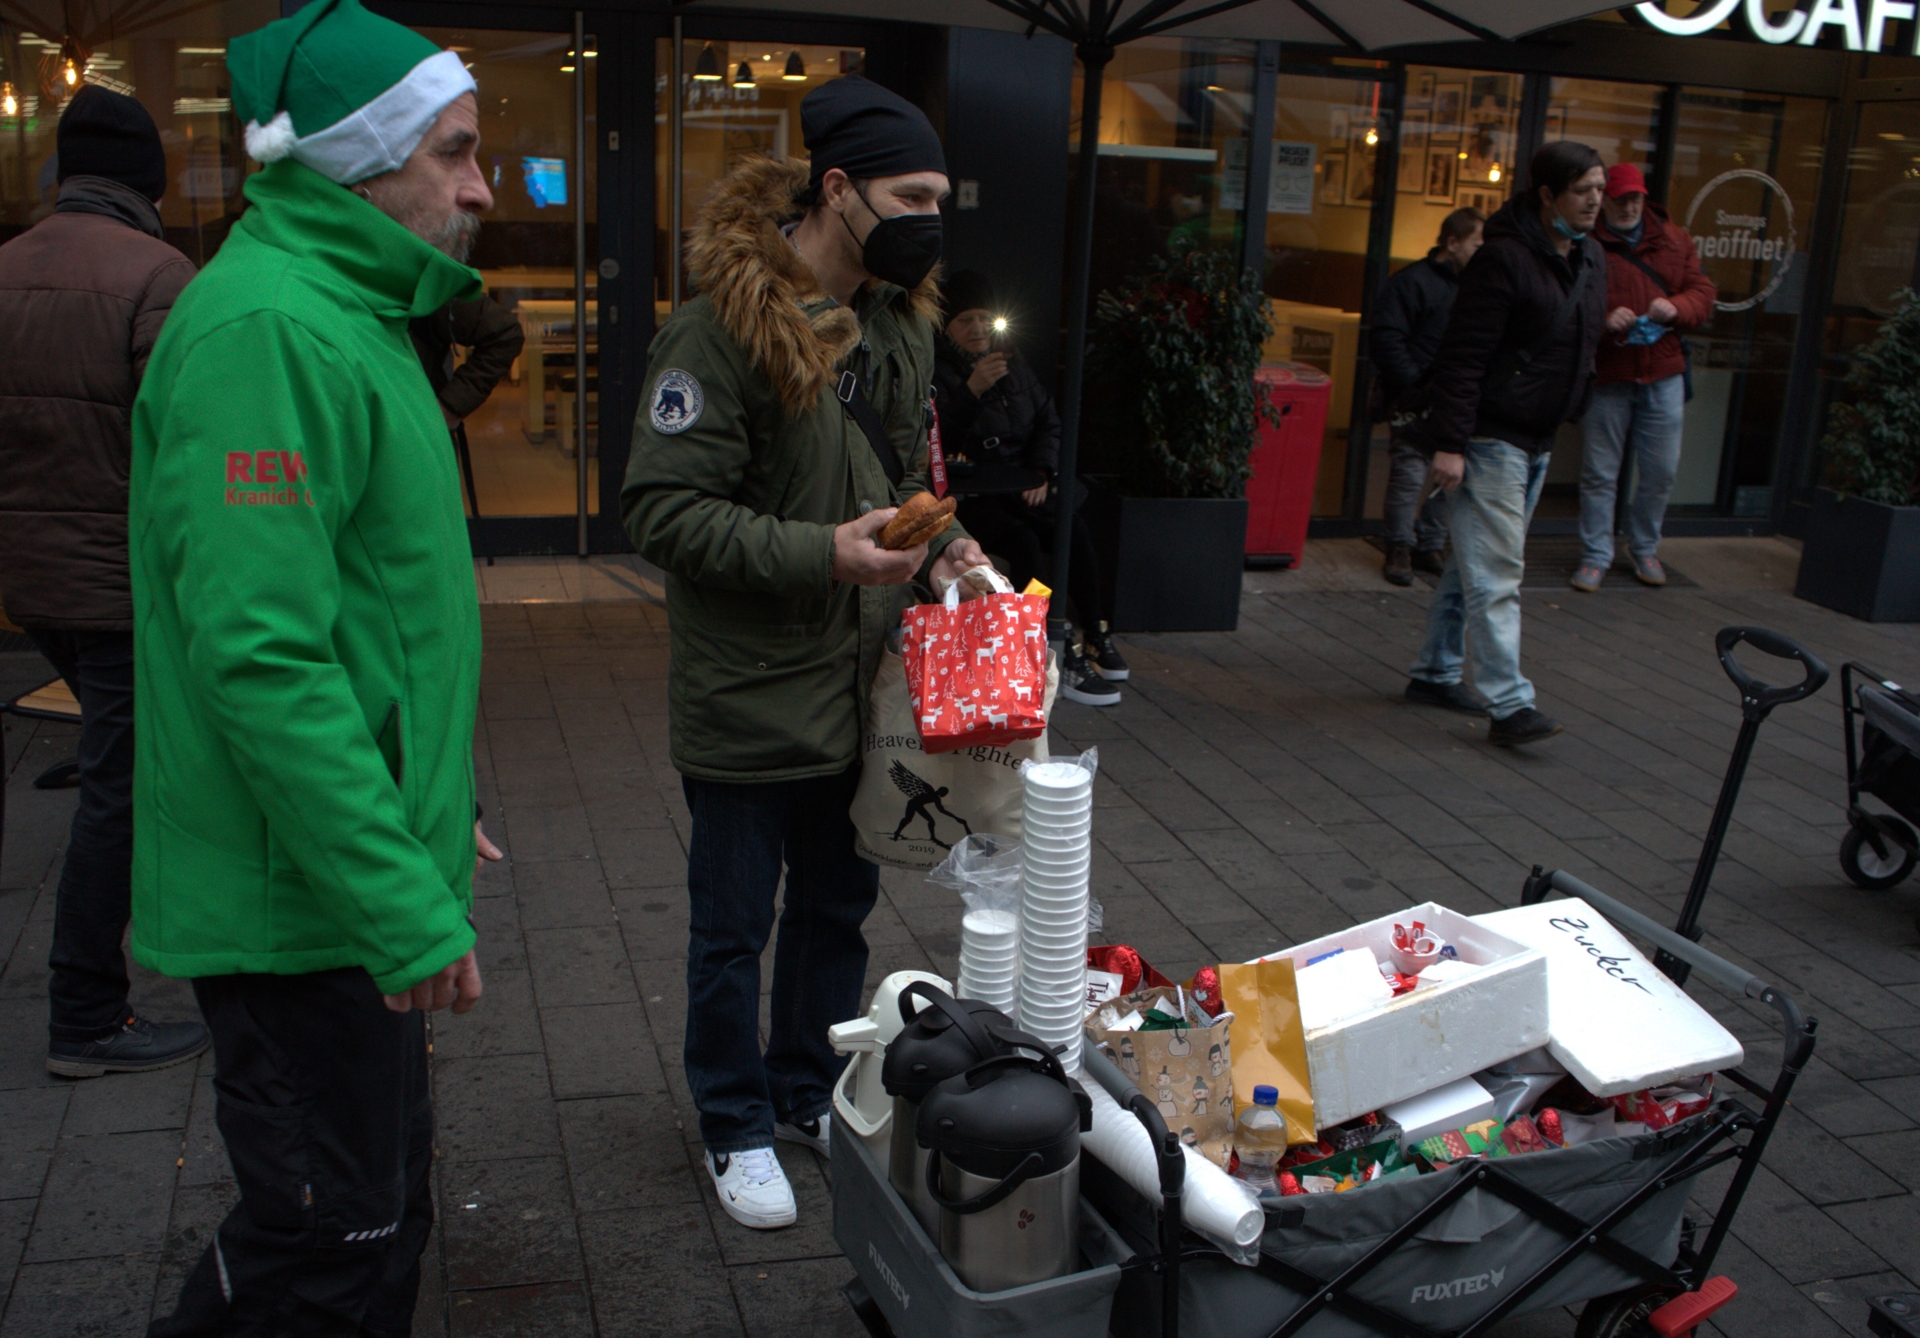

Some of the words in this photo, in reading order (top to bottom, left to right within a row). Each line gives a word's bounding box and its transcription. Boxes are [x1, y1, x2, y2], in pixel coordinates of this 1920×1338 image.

[1743, 0, 1920, 56] CAF
[1715, 209, 1768, 231] Sonntags
[931, 443, 942, 464] BEFORE
[933, 465, 945, 483] FLIGHT
[225, 486, 299, 505] Kranich
[909, 844, 935, 856] 2019
[1549, 917, 1657, 998] Zucker
[868, 1240, 904, 1302] FUXTEC
[1410, 1273, 1490, 1304] FUXTEC
